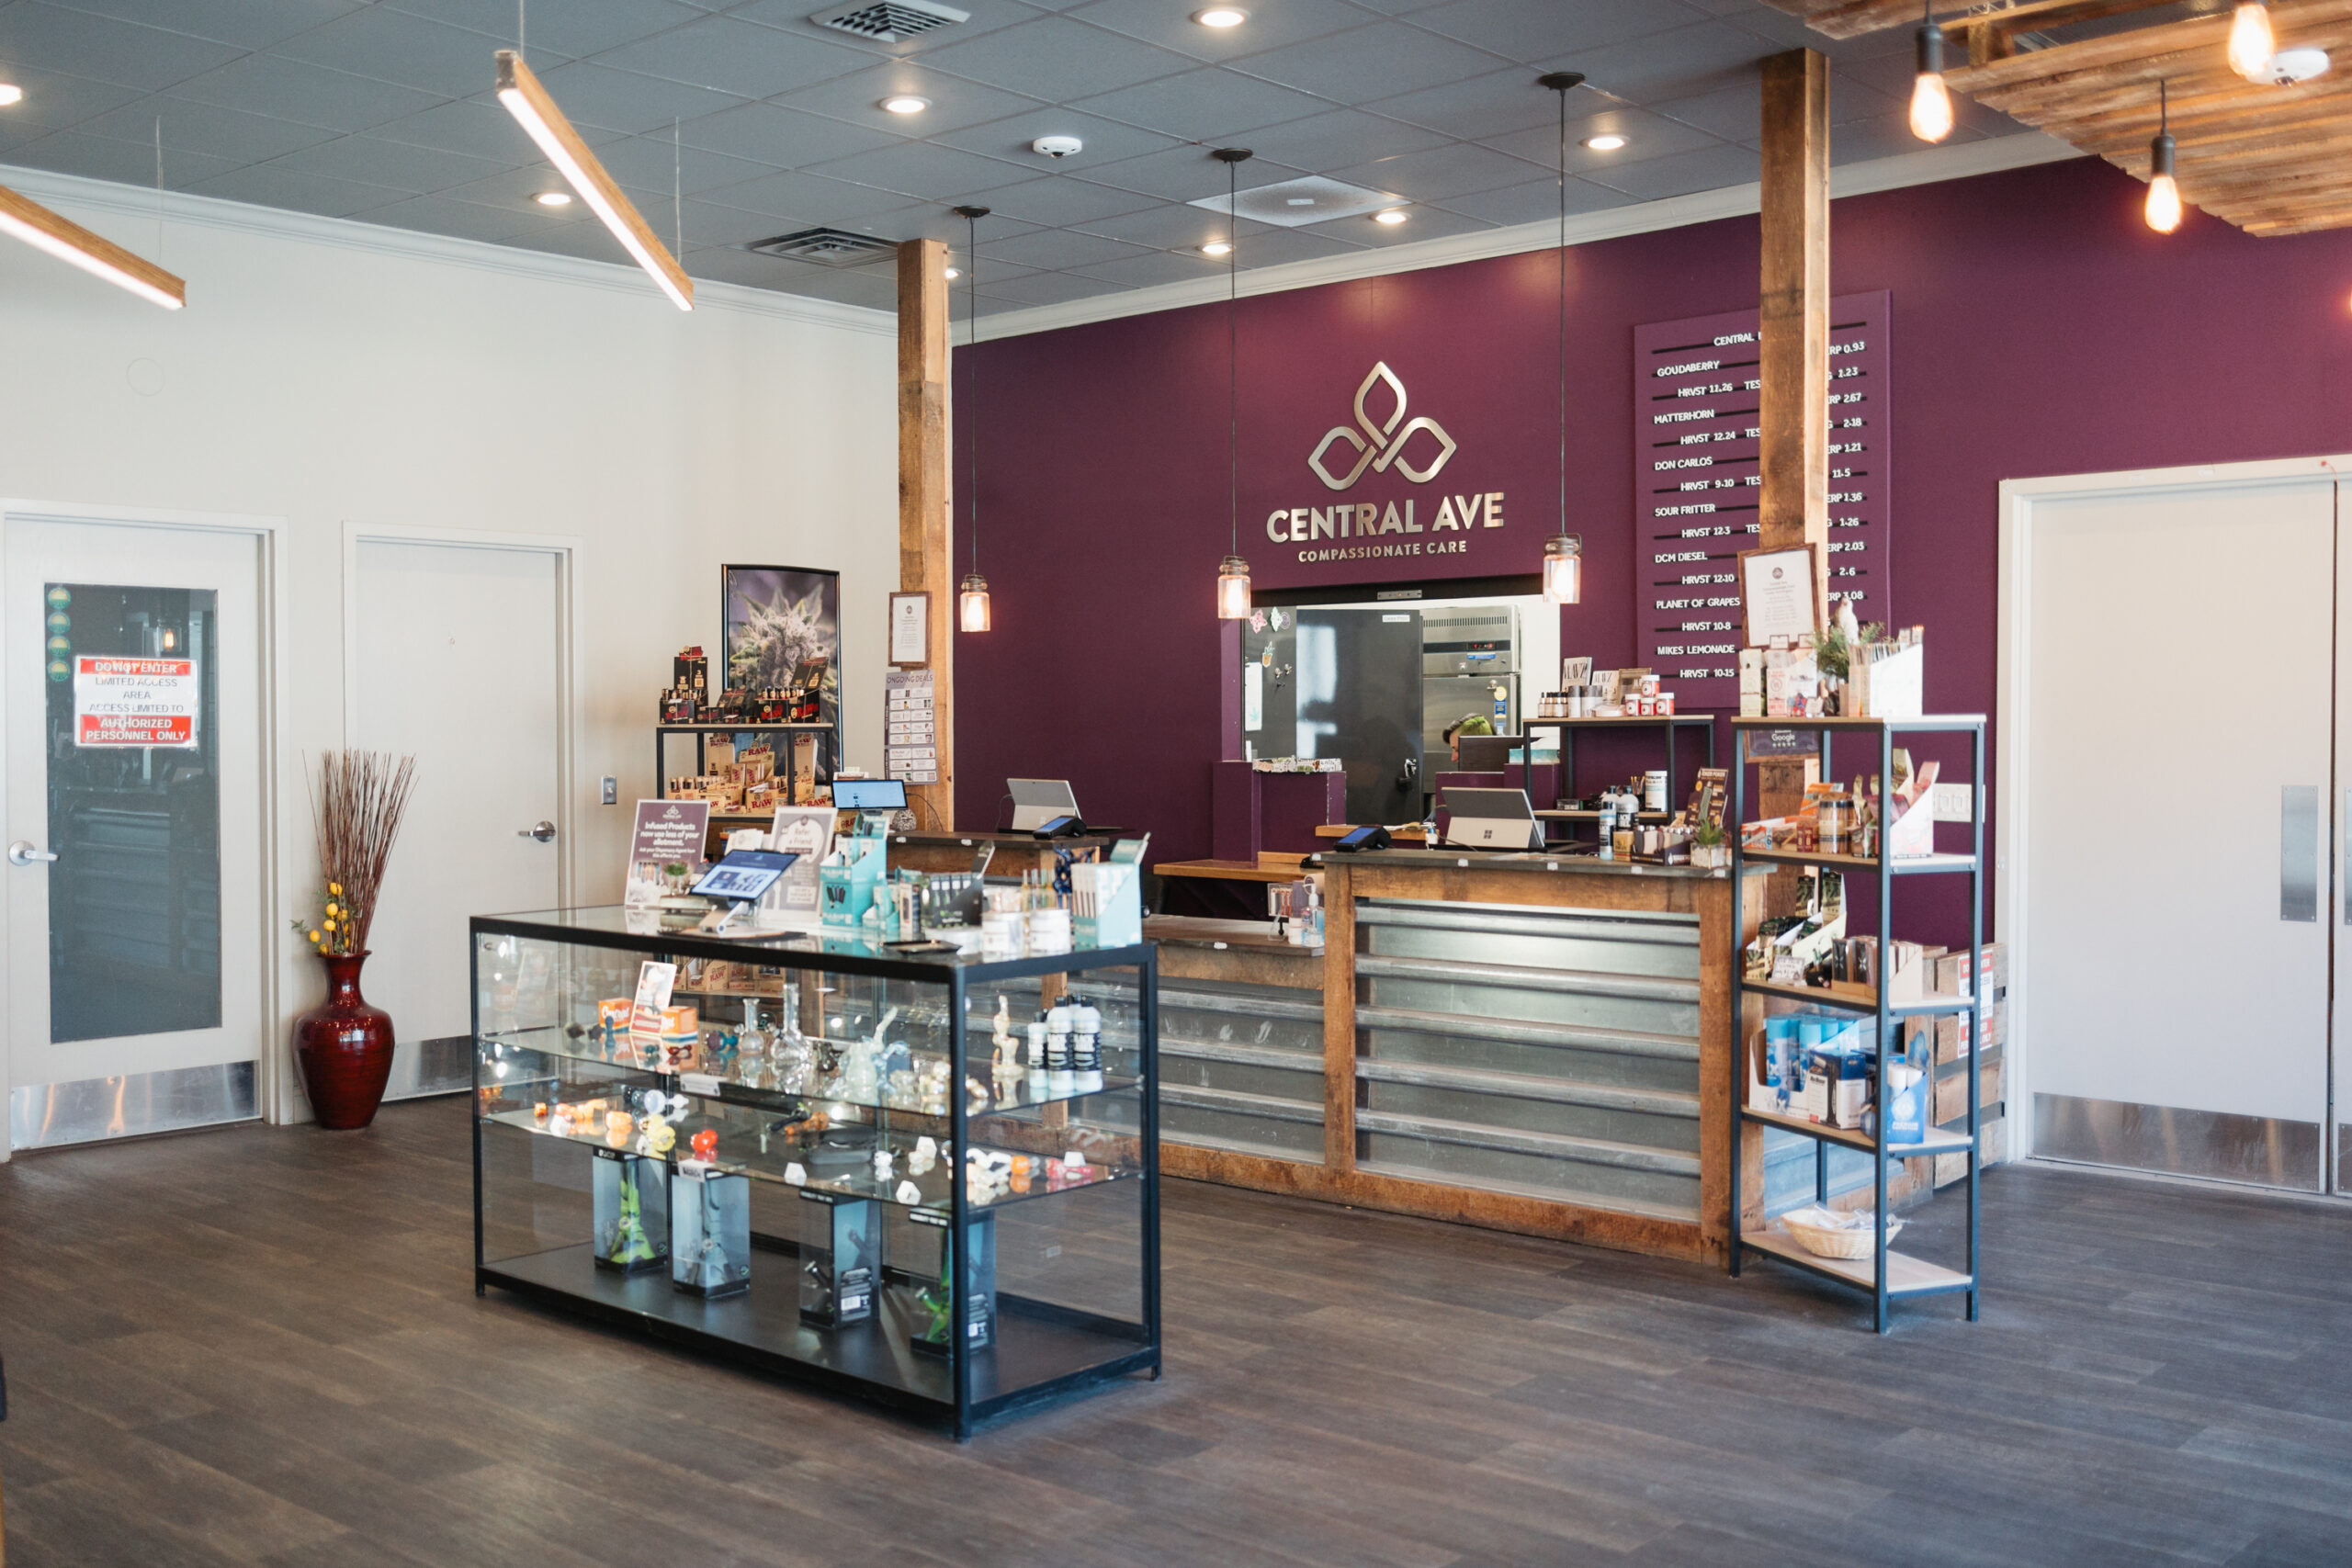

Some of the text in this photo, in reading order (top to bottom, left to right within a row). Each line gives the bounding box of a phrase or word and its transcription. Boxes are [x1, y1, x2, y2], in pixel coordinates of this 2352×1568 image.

[1713, 333, 1754, 346] CENTRAL
[1657, 360, 1720, 377] GOUDABERRY
[1843, 341, 1865, 354] 0.93
[1678, 387, 1707, 397] HRVST
[1709, 383, 1733, 393] 11.26
[1744, 379, 1761, 389] TES
[1838, 367, 1858, 378] 1.23
[1654, 409, 1714, 424] MATTERHORN
[1680, 434, 1710, 445] HRVST
[1713, 431, 1736, 441] 12.24
[1745, 428, 1760, 437] TES
[1655, 460, 1675, 470] DON
[1678, 457, 1713, 468] CARLOS
[1680, 480, 1709, 491] HRVST
[1745, 476, 1760, 485] TES
[1655, 507, 1679, 517] SOUR
[1680, 503, 1715, 514] FRITTER
[1266, 491, 1504, 544] CENTRAL AVE
[1681, 527, 1711, 538] HRVST
[1298, 540, 1467, 563] COMPASSIONATE CARE
[1655, 554, 1676, 563] DCM
[1678, 551, 1708, 561] DIESEL
[1844, 542, 1865, 551] 2.03
[1682, 575, 1711, 585] HRVST
[1657, 600, 1689, 609] PLANET
[1690, 599, 1704, 607] OF
[1707, 597, 1740, 606] GRAPES
[1682, 622, 1711, 631] HRVST
[1657, 645, 1735, 655] MIKES LEMONADE
[96, 661, 113, 671] DO
[141, 663, 177, 673] ENTER
[1680, 669, 1709, 678] HRVST
[96, 677, 177, 687] LIMITED ACCESS
[123, 691, 152, 699] AREA
[89, 704, 184, 713] ACCESS LIMITED TO
[100, 718, 172, 728] AUTHORIZED
[85, 730, 186, 741] PERSONNEL ONLY
[1771, 733, 1795, 743] Google
[748, 746, 770, 756] RAW
[752, 799, 773, 808] RAW
[807, 798, 827, 807] RAW
[668, 821, 695, 830] Products
[709, 971, 725, 982] RAW
